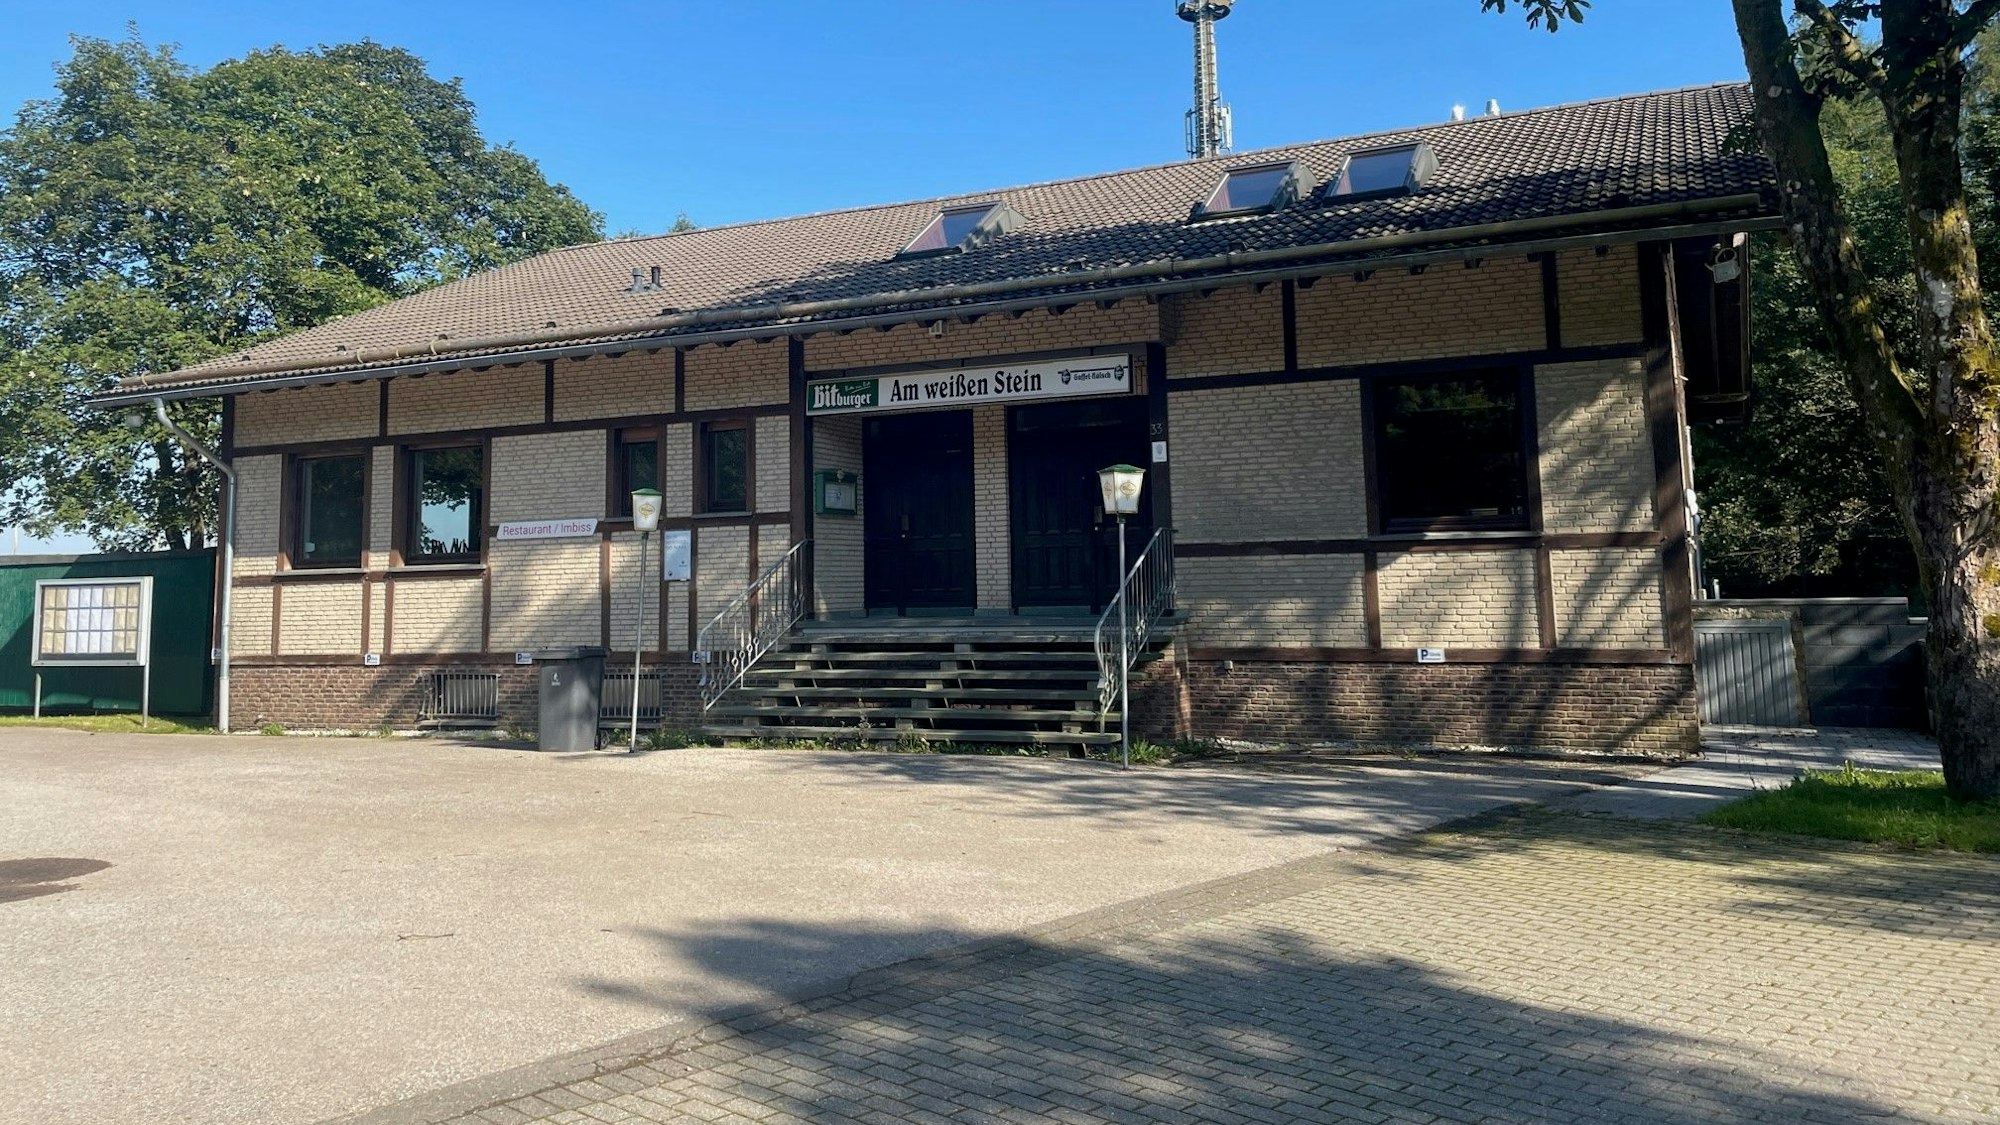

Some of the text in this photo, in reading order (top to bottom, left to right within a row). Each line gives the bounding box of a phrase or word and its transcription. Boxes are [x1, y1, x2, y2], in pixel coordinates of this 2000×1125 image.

[890, 379, 919, 402] Am
[924, 374, 989, 399] weißen
[994, 369, 1042, 394] Stein
[813, 384, 872, 409] Bitburger
[1150, 423, 1163, 435] 33
[503, 525, 552, 536] Restaurant
[561, 522, 592, 533] Imbiss
[1421, 649, 1428, 660] P
